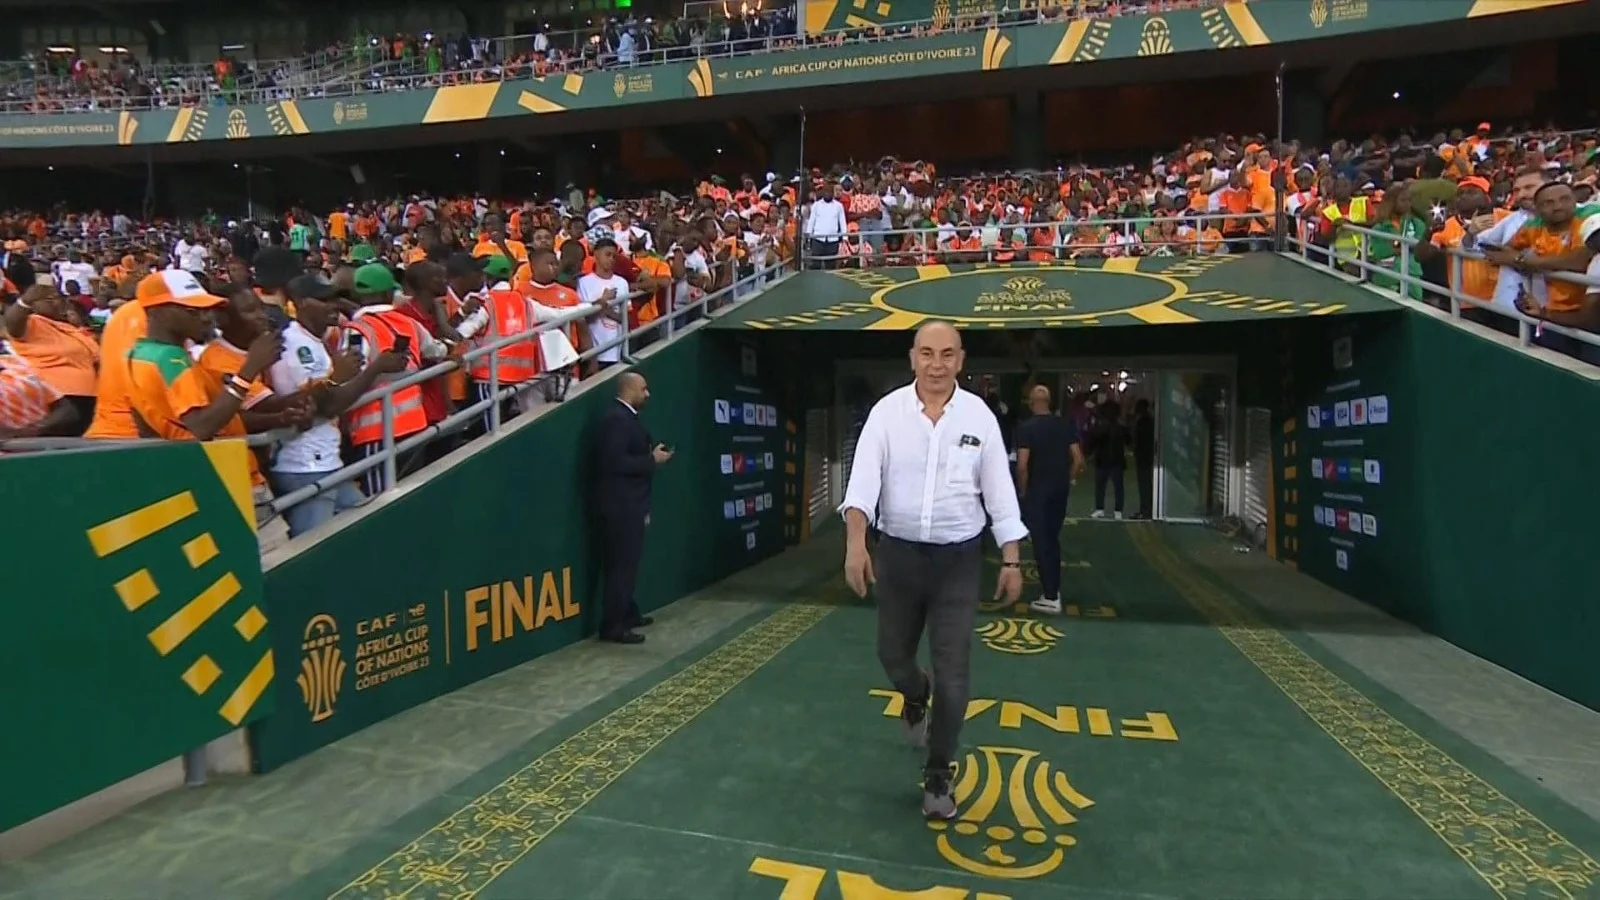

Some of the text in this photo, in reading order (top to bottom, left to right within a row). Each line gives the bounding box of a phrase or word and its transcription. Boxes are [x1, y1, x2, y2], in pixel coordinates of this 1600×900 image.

[772, 63, 807, 76] AFRICA
[808, 61, 828, 71] CUP
[829, 60, 842, 69] OF
[844, 55, 888, 68] NATIONS
[889, 52, 915, 63] CÔTE
[916, 47, 962, 60] D'IVOIRE
[964, 46, 977, 56] 23
[356, 612, 397, 636] CAF
[465, 566, 580, 651] FINAL
[356, 624, 429, 658] AFRICA CUP
[356, 640, 429, 676] OF NATIONS
[356, 673, 381, 690] CÔTE
[380, 660, 420, 683] D'IVOIRE
